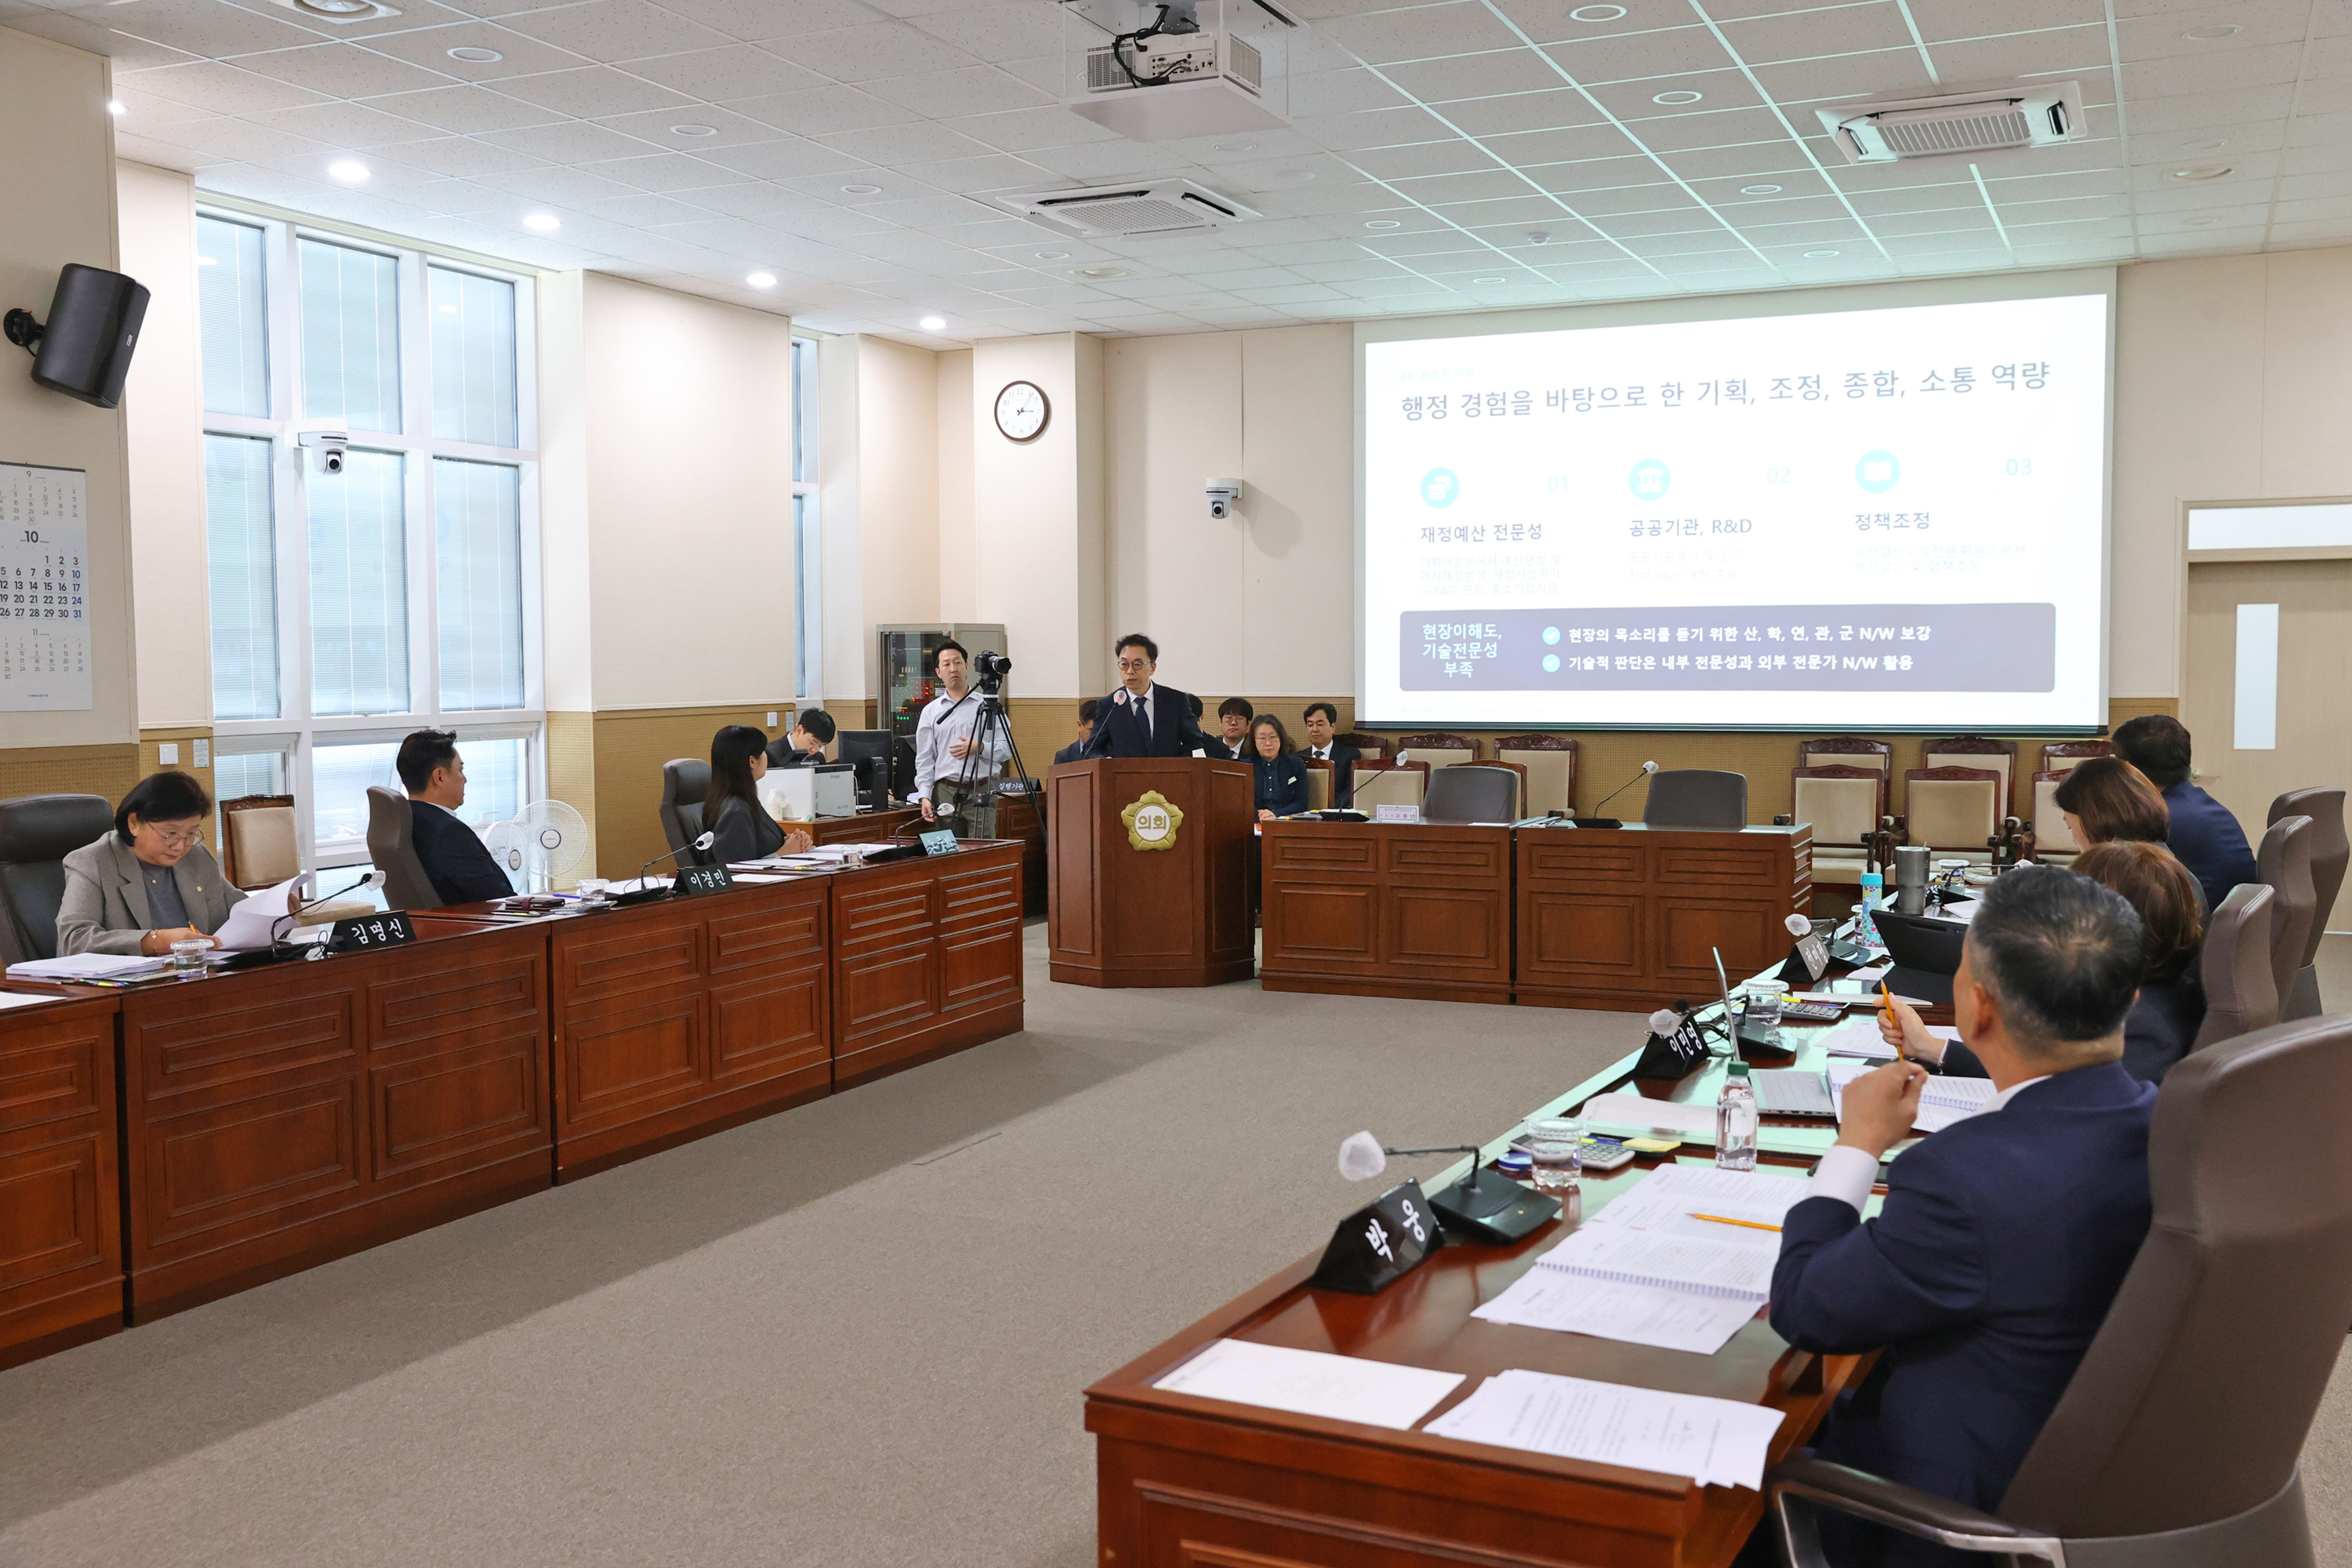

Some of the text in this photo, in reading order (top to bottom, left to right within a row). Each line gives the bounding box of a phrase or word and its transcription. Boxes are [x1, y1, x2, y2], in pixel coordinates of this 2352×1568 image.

[1401, 361, 2050, 422] 행정 경험을 바탕으로 한 기획, 조정, 종합, 소통 역량
[1766, 466, 1791, 484] 02
[2005, 457, 2032, 476] 03
[1548, 476, 1568, 492] 01
[1629, 517, 1752, 537] 공공기관, R&D
[1855, 511, 1929, 532] 정책조정
[25, 531, 38, 543] 10
[1421, 522, 1542, 543] 재정예산 전문성
[72, 570, 80, 579] 10
[14, 581, 23, 590] 13
[14, 594, 24, 603] 20
[30, 595, 38, 604] 21
[58, 596, 67, 604] 23
[0, 608, 10, 616] 26
[30, 608, 39, 617] 28
[58, 609, 68, 618] 30
[1422, 622, 1502, 641] 현장이해도,
[1568, 625, 1932, 643] 현장의 목소리를 듣기 위한 산, 학, 연, 관, 군 N/W 보강
[1422, 641, 1497, 659] 기술전문성
[1443, 661, 1474, 678] 부족
[1569, 654, 1914, 671] 기술적 판단은 내부 전문성과 외부 전문가 N/W 활용
[1138, 815, 1167, 830] 의회
[690, 869, 726, 889] 이경민
[351, 918, 405, 945] 김명신
[1669, 1022, 1703, 1060] 이민영
[1365, 1199, 1425, 1262] 박 웅
